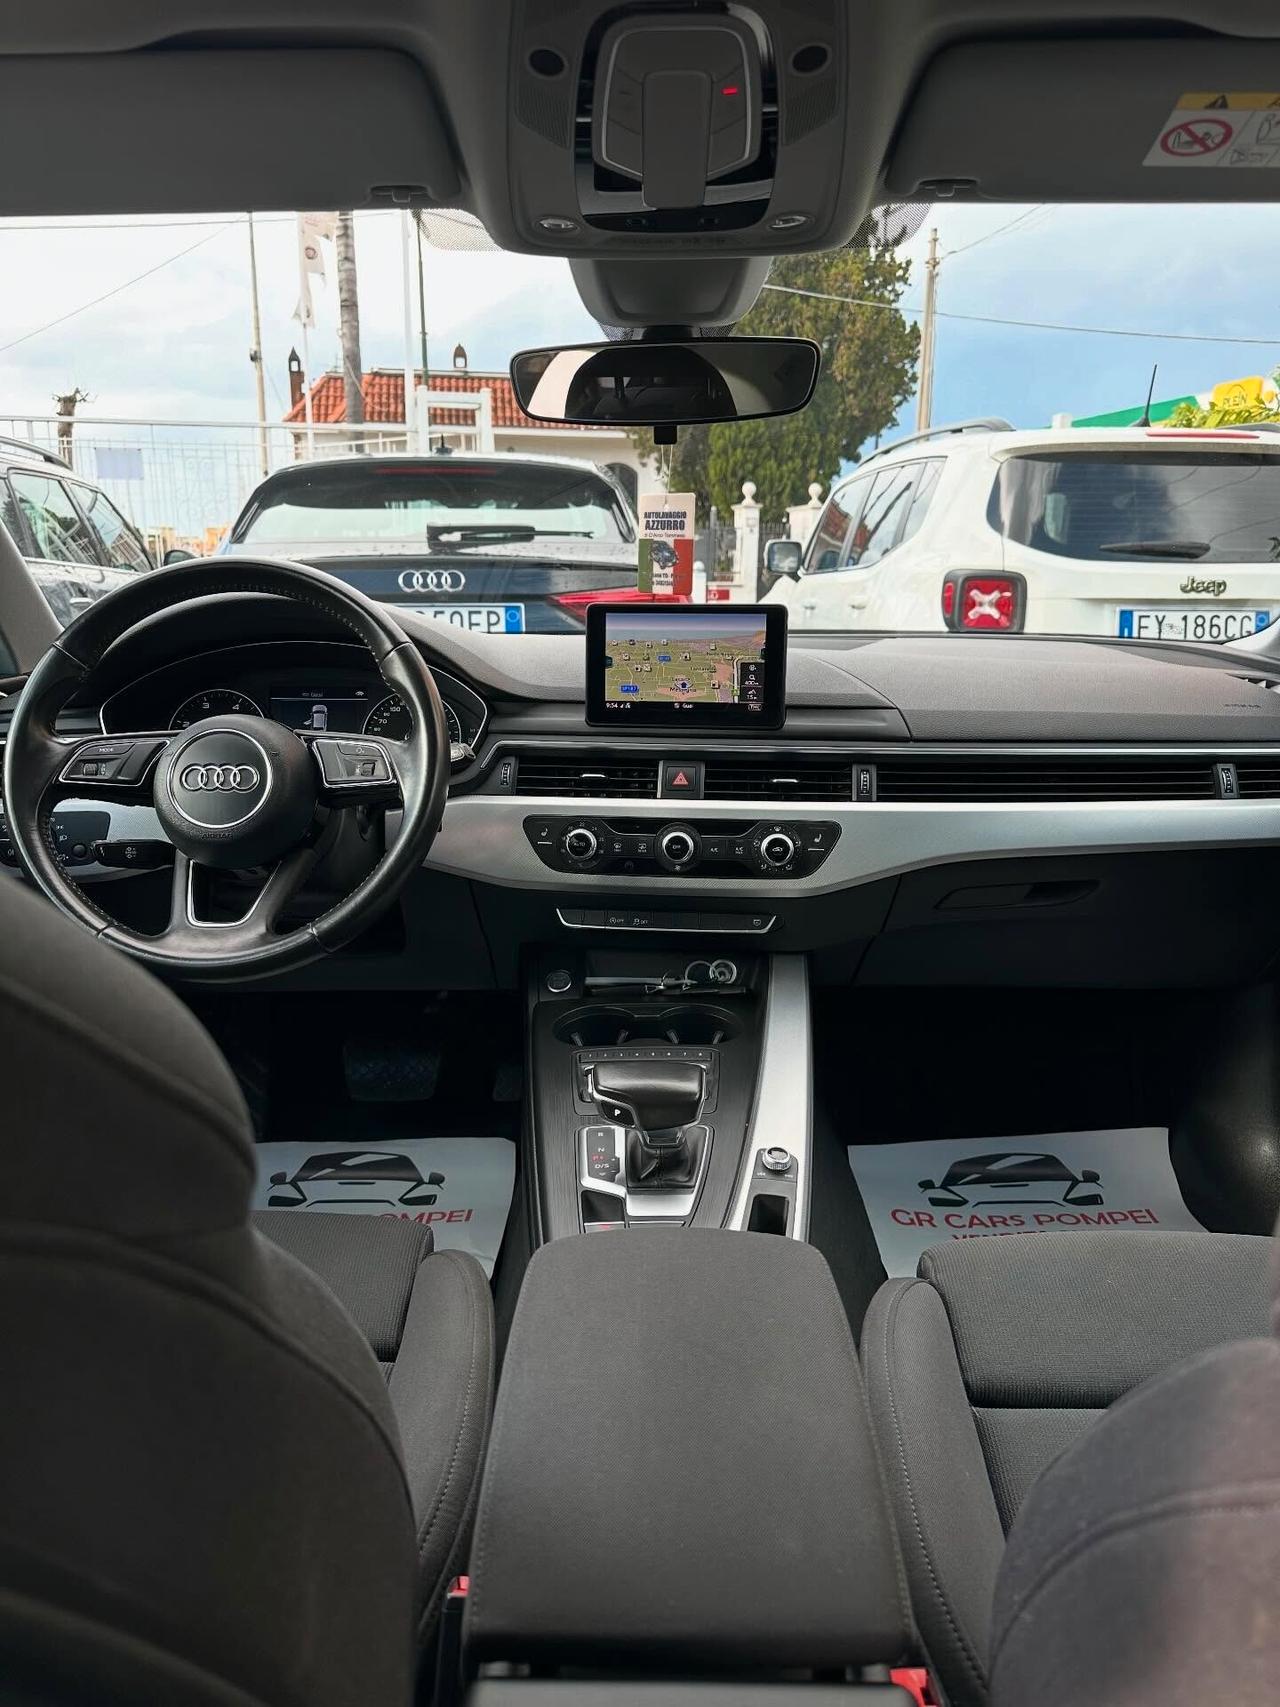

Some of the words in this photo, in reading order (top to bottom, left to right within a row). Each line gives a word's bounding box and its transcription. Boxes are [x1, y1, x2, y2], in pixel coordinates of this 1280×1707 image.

[644, 511, 687, 519] AUTOLAVAGGIO
[645, 519, 686, 531] AZZURRO
[1180, 576, 1227, 596] Jeep
[1181, 614, 1252, 640] 186CG
[614, 1108, 622, 1117] P
[891, 1208, 938, 1228] GR
[944, 1213, 1026, 1229] CARS
[1032, 1208, 1160, 1226] POMPEI
